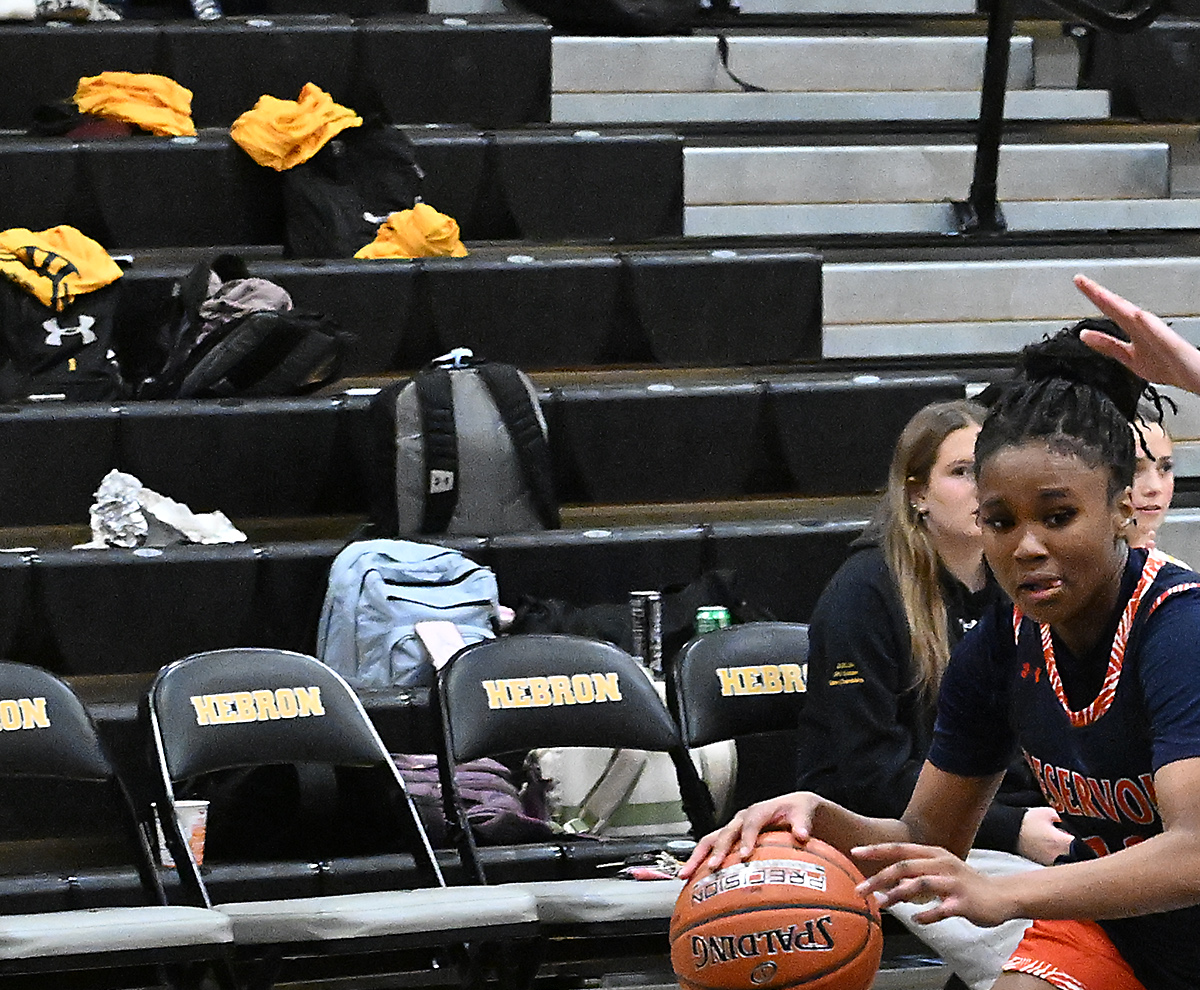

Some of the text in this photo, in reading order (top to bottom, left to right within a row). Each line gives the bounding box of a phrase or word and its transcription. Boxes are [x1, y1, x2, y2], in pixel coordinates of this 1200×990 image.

[482, 672, 623, 709] HEBRON
[716, 664, 807, 697] HEBR
[0, 697, 51, 731] ON
[190, 686, 326, 726] HEBRON
[690, 867, 827, 904] PRECISION
[691, 914, 835, 971] SPALDING
